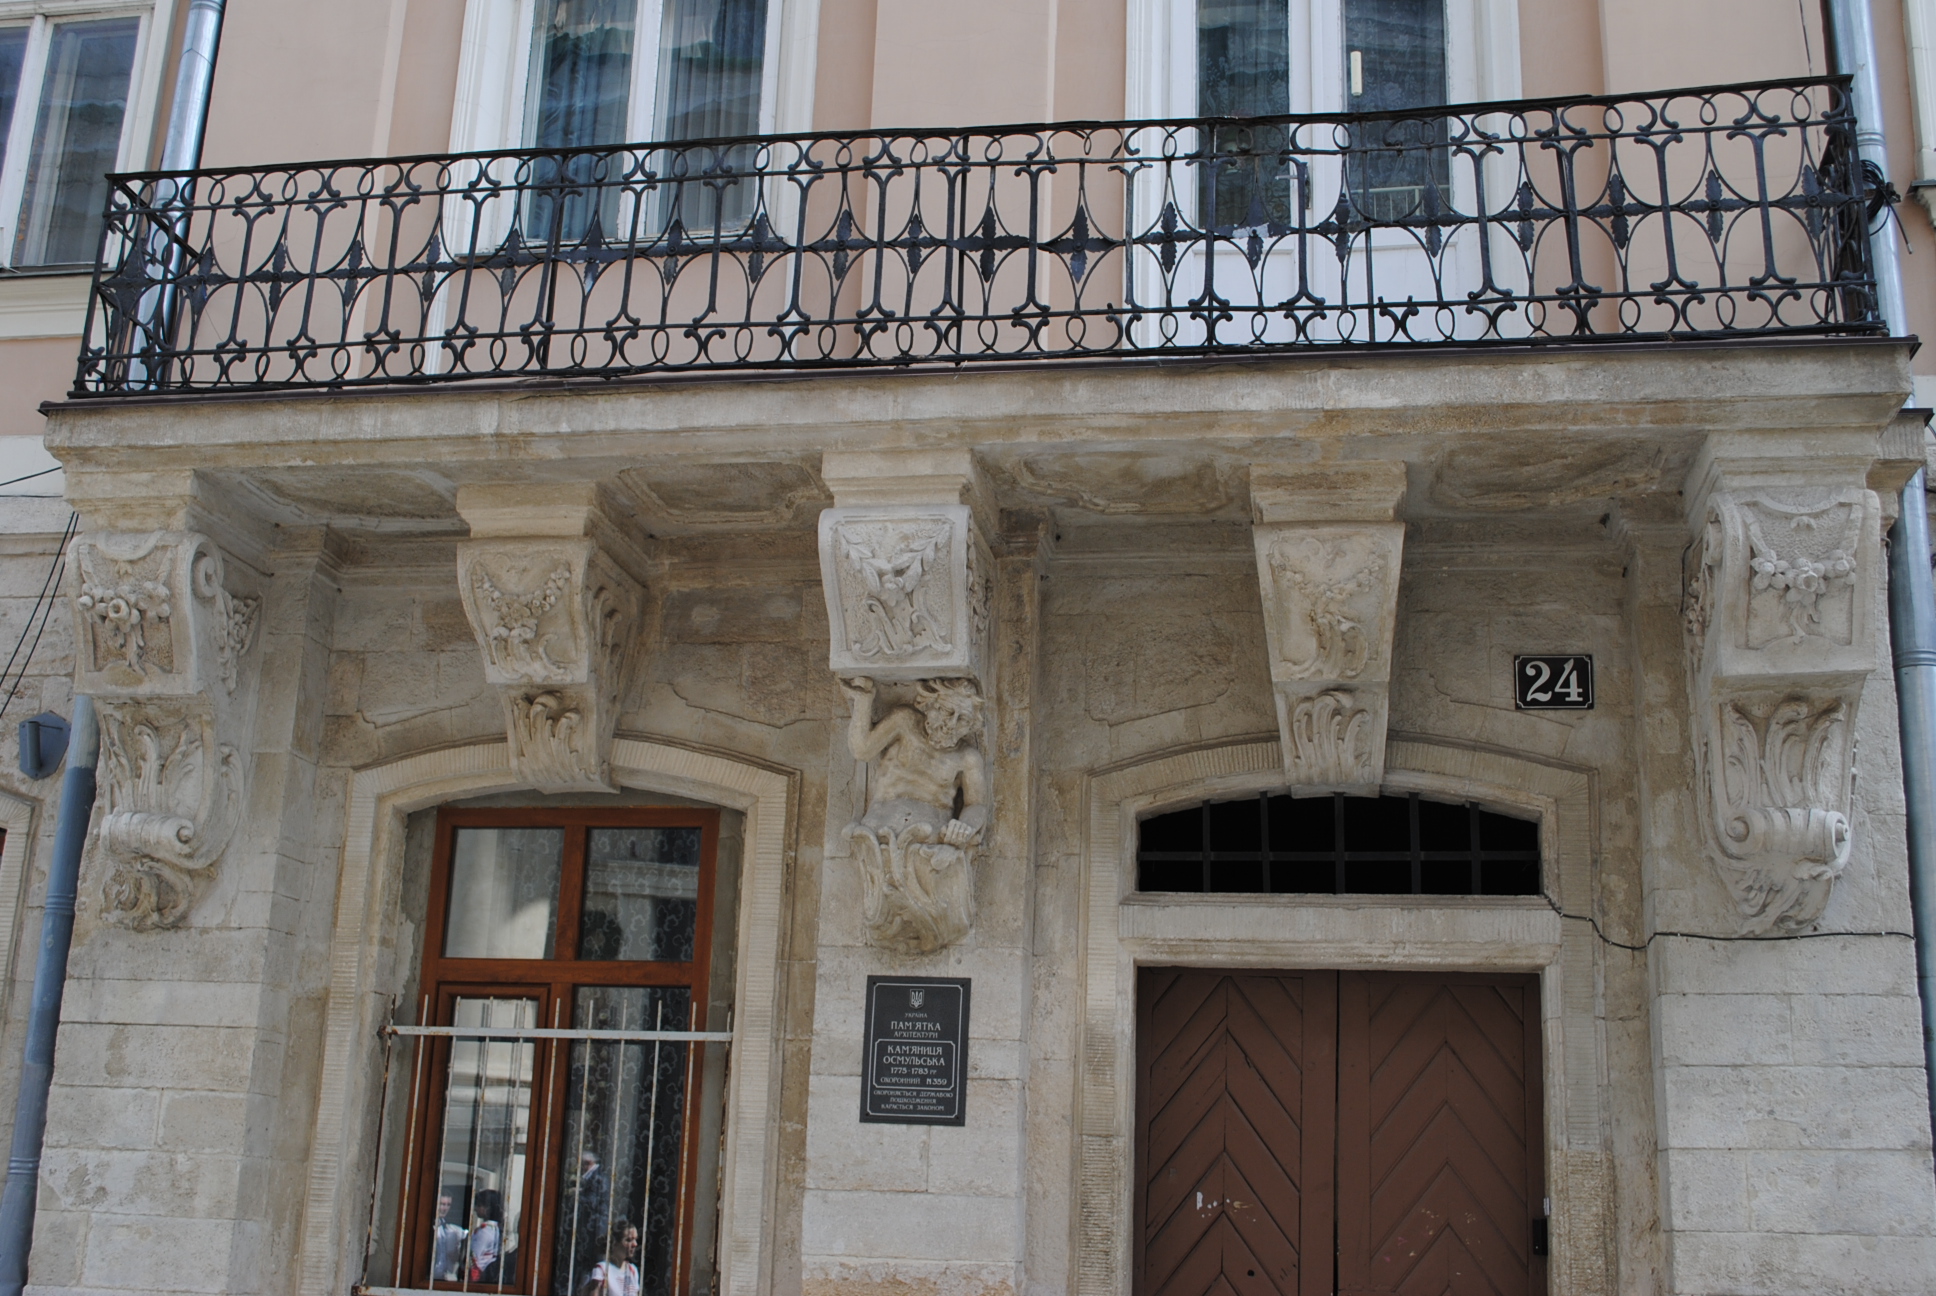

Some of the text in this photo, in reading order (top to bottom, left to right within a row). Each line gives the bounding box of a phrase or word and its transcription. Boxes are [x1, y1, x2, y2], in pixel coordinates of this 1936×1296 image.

[1525, 658, 1583, 702] 24
[891, 1021, 941, 1031] ПАМ'ЯТКА
[887, 1045, 943, 1055] КАМ'ЯНИЦЯ
[883, 1056, 945, 1066] ОСМУЛЬСЬКА
[880, 1077, 921, 1085] ОХОРОННИЙ
